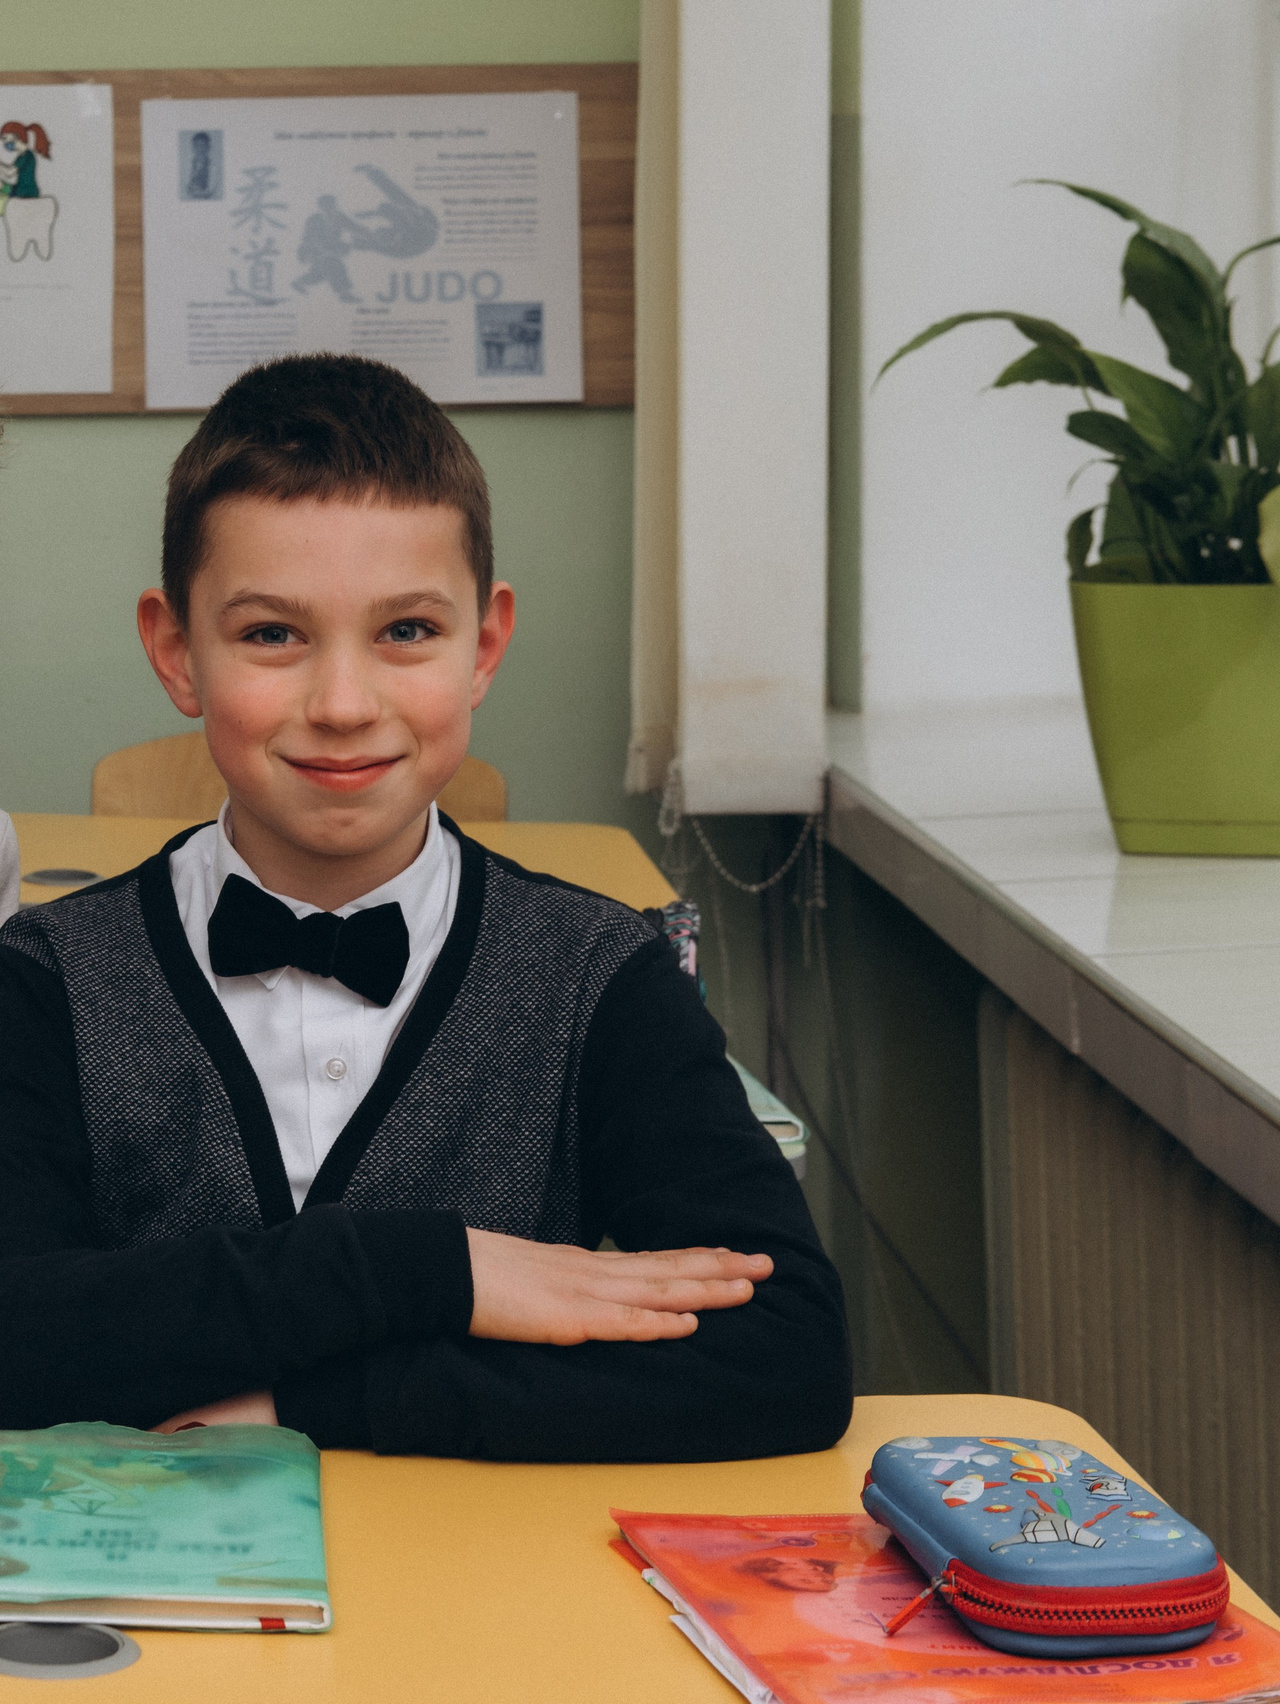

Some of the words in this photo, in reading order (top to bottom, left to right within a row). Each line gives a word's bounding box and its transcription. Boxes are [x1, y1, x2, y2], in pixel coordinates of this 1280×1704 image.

[375, 269, 505, 304] JUDO
[933, 1657, 1196, 1677] ДОСЛІДЖУЮ
[1210, 1653, 1240, 1667] Я
